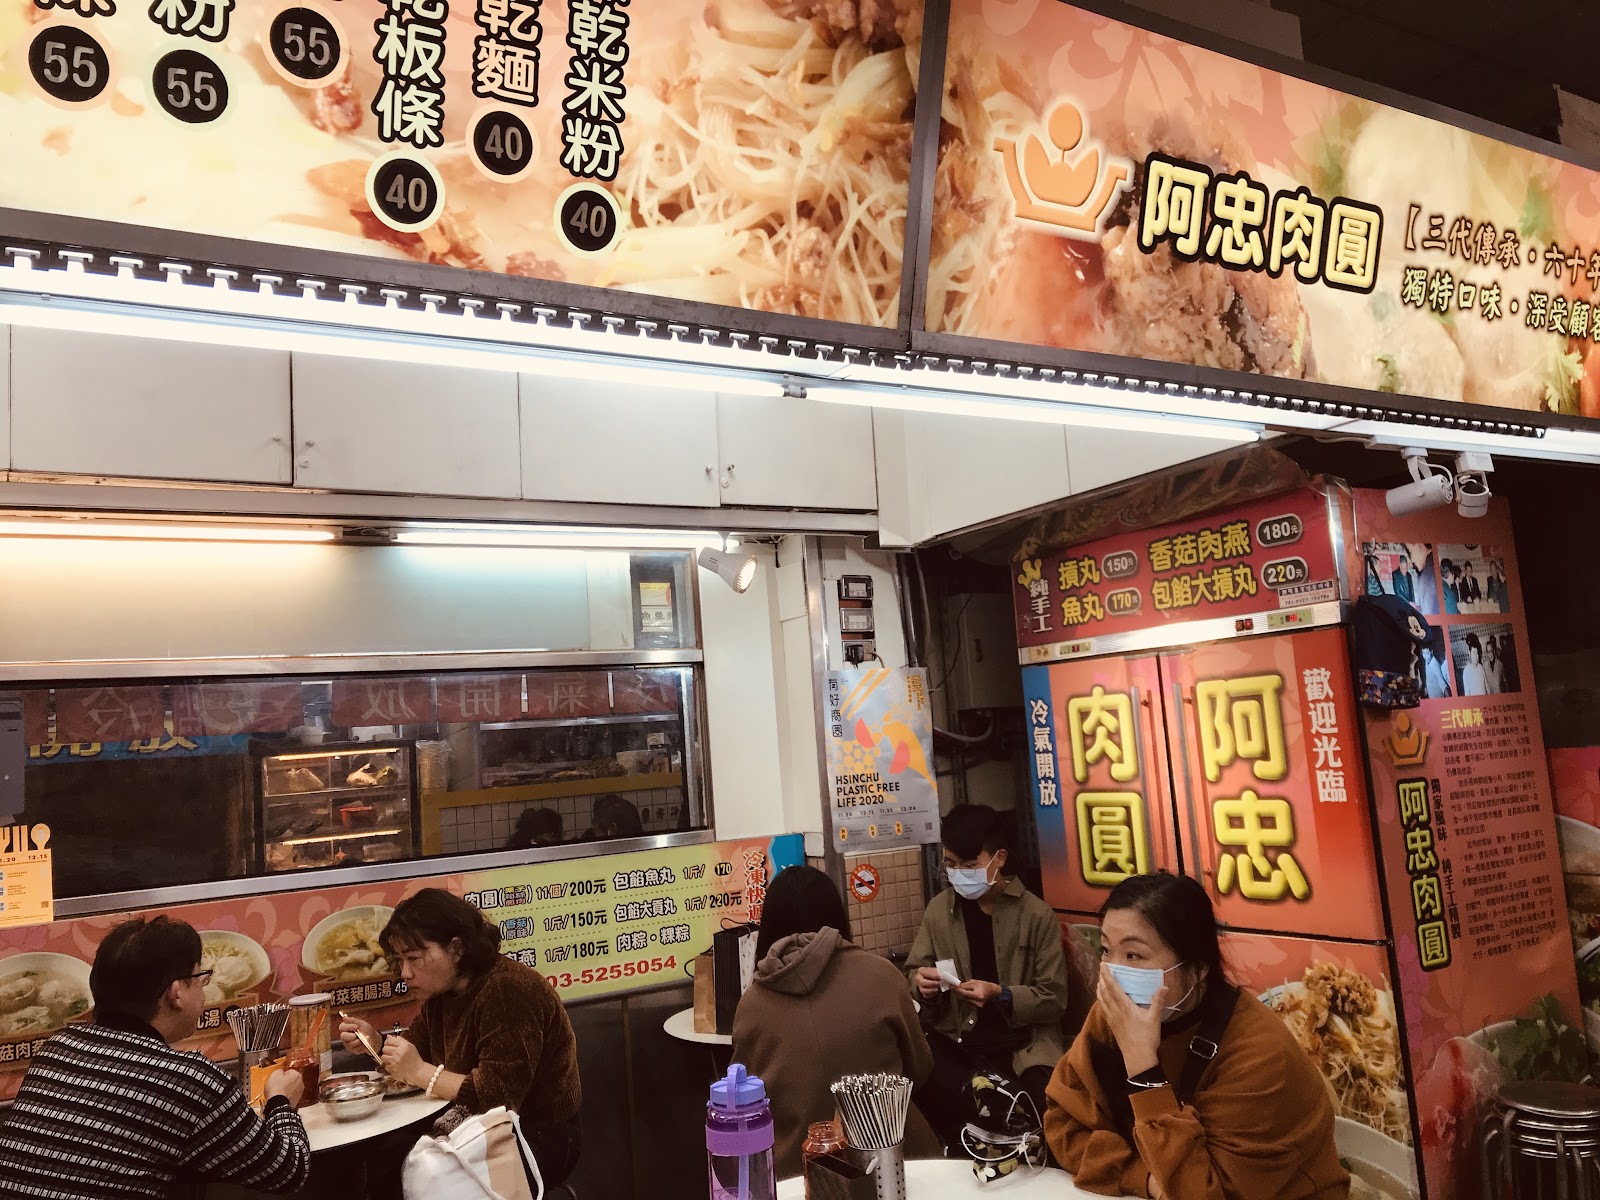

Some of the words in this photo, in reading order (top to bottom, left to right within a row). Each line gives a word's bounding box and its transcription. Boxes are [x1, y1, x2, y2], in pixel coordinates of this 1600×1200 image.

[283, 22, 331, 66] 55
[43, 41, 98, 88] 55
[165, 73, 218, 112] 55
[563, 0, 629, 179] 乾米粉
[484, 125, 523, 160] 40
[385, 175, 428, 212] 40
[570, 202, 608, 238] 40
[1139, 153, 1383, 294] 阿忠肉圓
[1107, 555, 1135, 572] 150元
[1149, 522, 1251, 572] 香菇肉燕
[1263, 520, 1299, 542] 180元
[1267, 565, 1304, 584] 220元
[1030, 579, 1053, 633] 純手工
[1061, 595, 1104, 626] 魚丸
[1112, 593, 1139, 611] 170元
[1303, 667, 1347, 803] 歡迎光臨
[1440, 707, 1484, 729] 三代傳承
[1030, 699, 1058, 807] 冷氣開放
[836, 773, 880, 785] HSINCHU
[837, 784, 875, 797] PLASTIC
[877, 782, 900, 793] FREE
[1067, 686, 1149, 887] 肉圓
[1196, 672, 1311, 901] 阿忠
[837, 797, 857, 808] LIFE
[859, 795, 884, 806] 2020
[613, 866, 675, 891] 包餡魚丸
[1396, 776, 1453, 973] 阿忠肉圓
[614, 897, 677, 923] 包餡大貢丸
[394, 981, 408, 994] 45
[547, 955, 677, 990] 03-5255054
